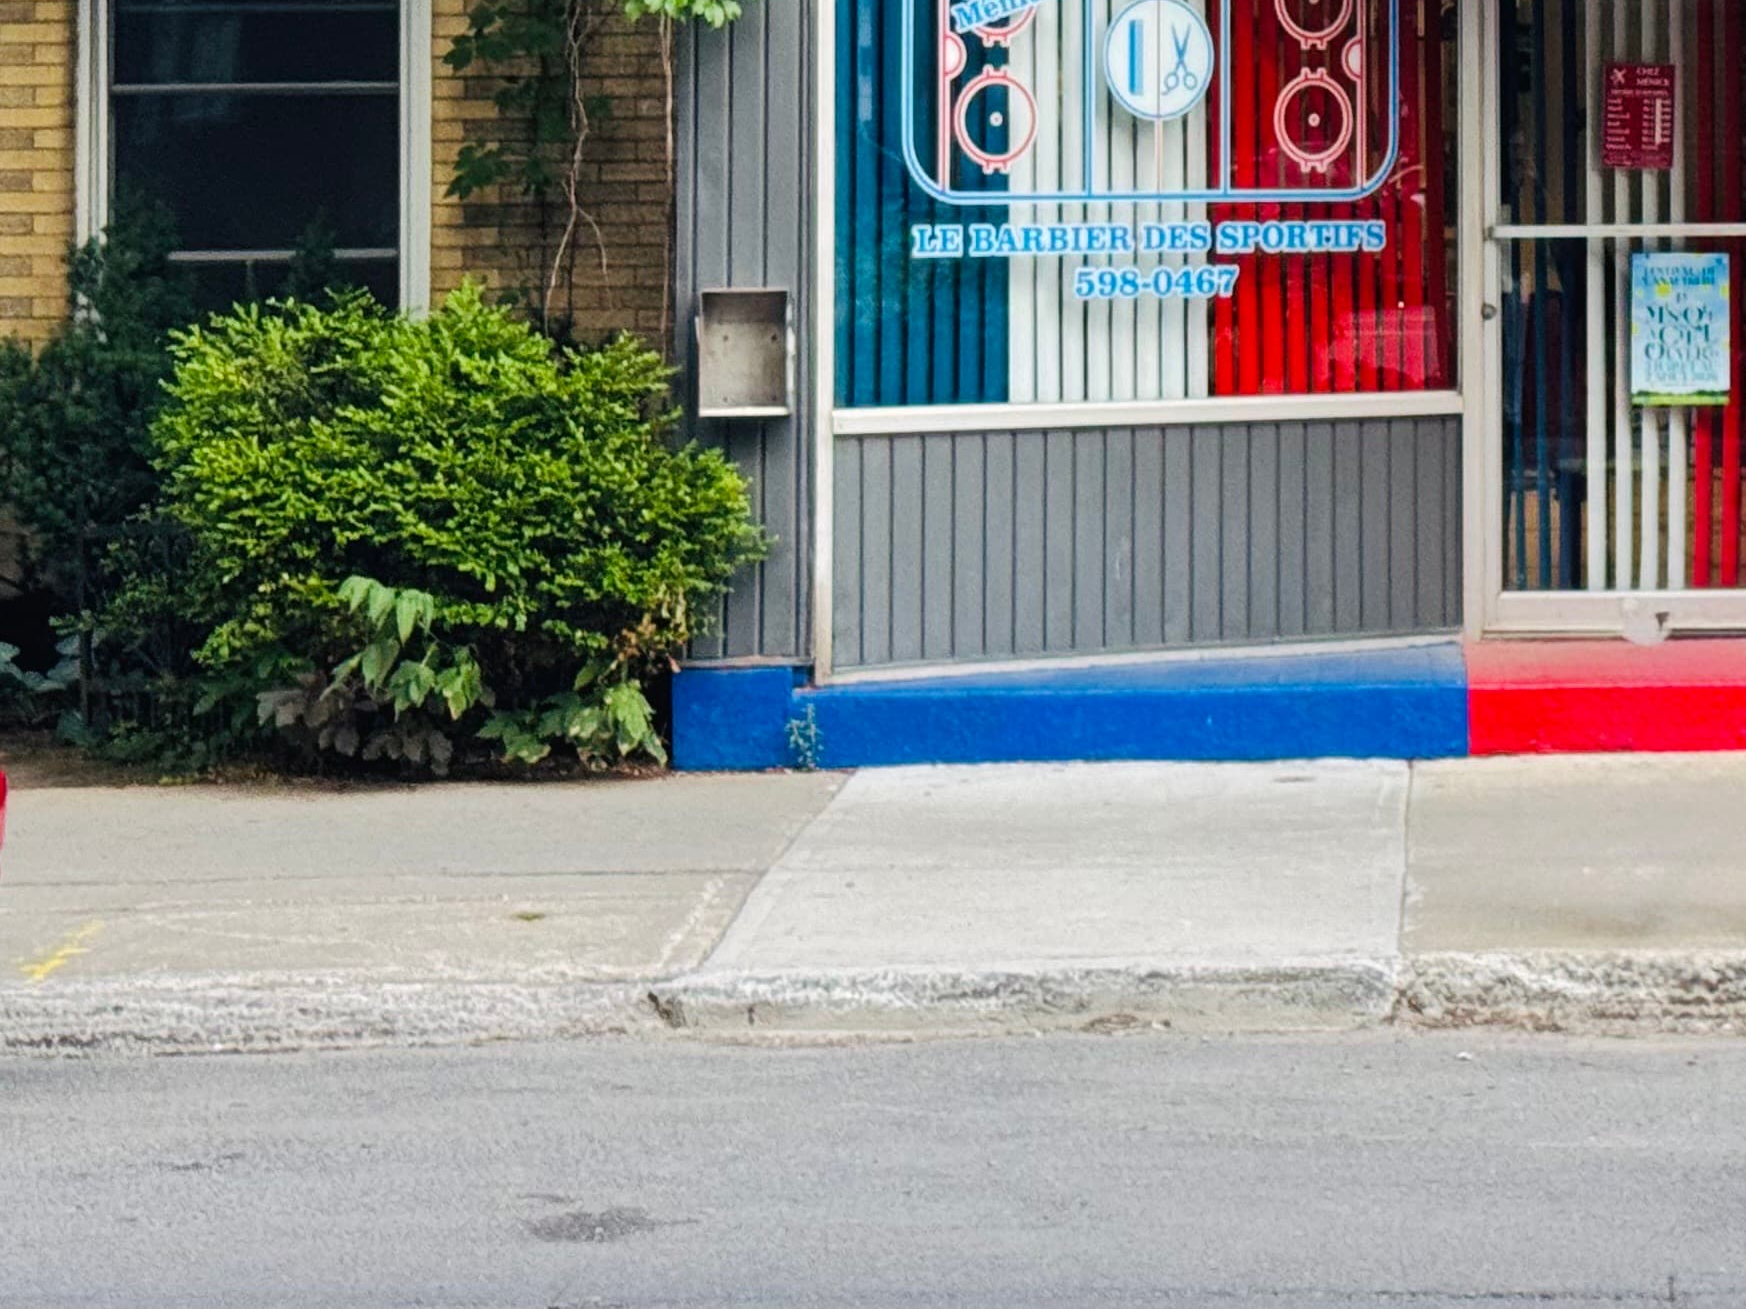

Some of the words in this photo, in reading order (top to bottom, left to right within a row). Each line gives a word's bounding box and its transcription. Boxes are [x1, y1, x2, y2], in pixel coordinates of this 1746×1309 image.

[916, 227, 961, 253] LE
[972, 226, 1132, 252] BARBIER
[1142, 224, 1209, 250] DES
[1218, 223, 1385, 250] SPORTIFS
[1075, 268, 1238, 297] 598-0467
